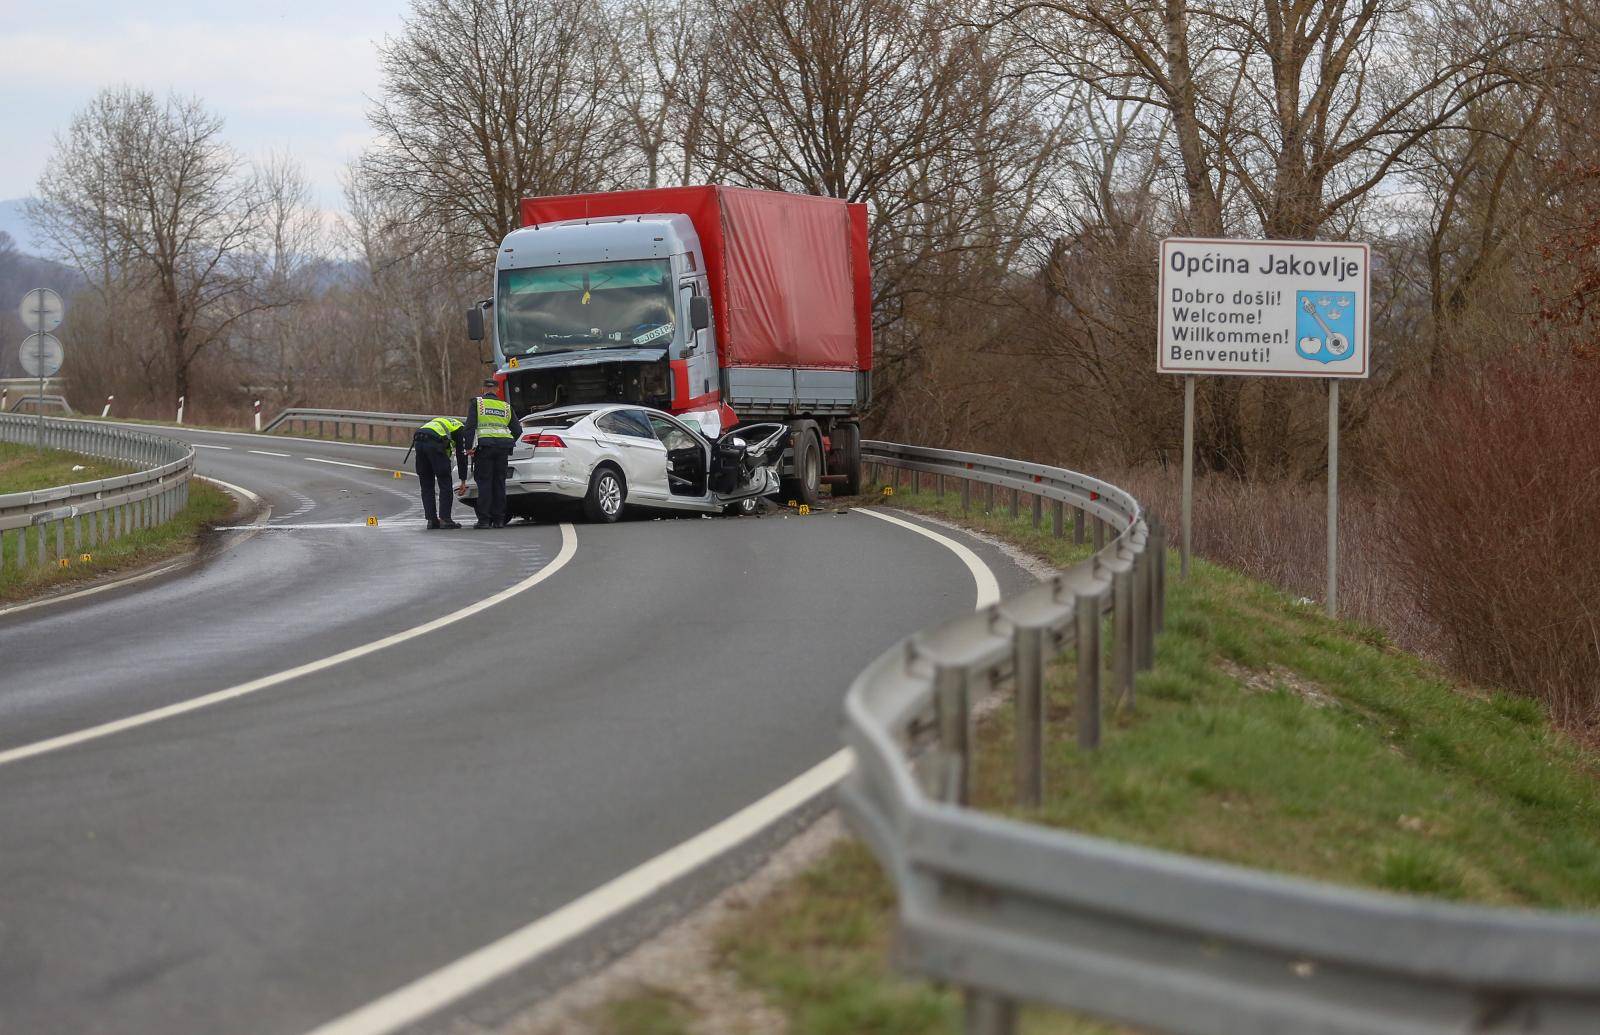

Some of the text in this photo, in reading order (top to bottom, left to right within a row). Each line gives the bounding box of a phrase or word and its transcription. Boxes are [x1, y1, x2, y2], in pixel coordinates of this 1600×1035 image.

[1171, 251, 1359, 282] Općina Jakovlje
[1172, 288, 1281, 306] Dobro došli!
[1172, 307, 1262, 324] Welcome!
[1172, 326, 1289, 344] Willkommen!
[1171, 346, 1270, 362] Benvenuti!
